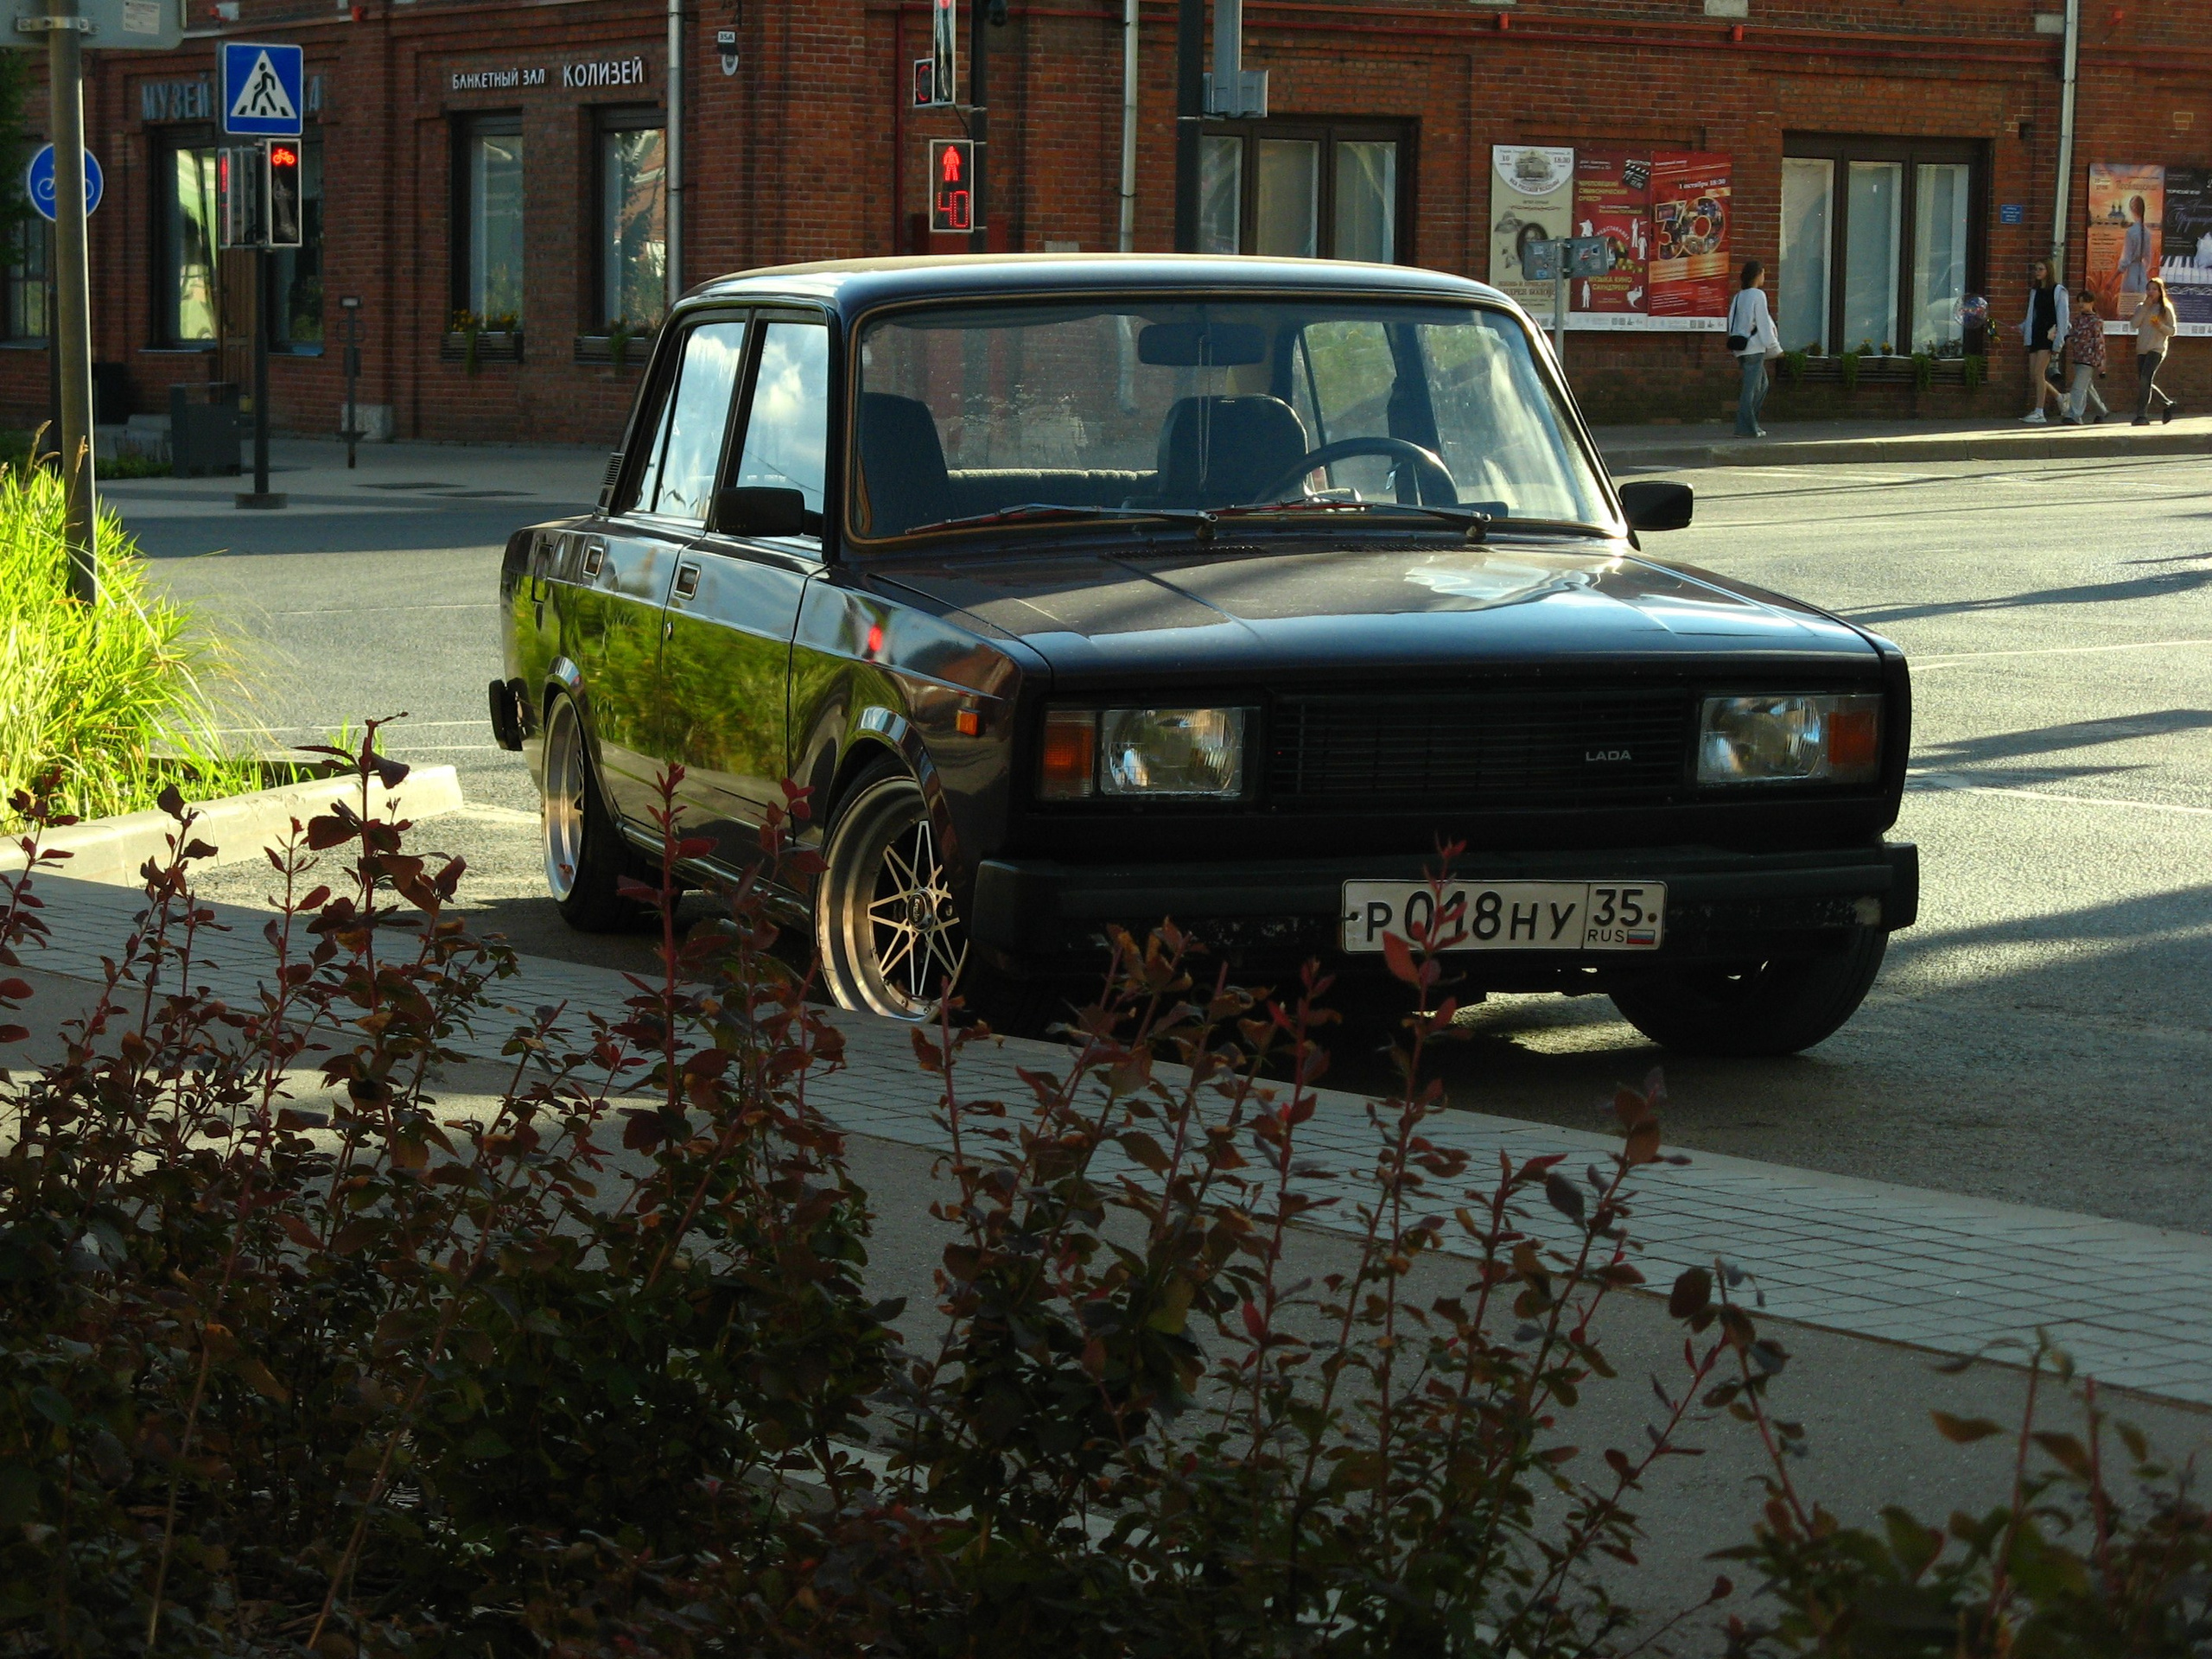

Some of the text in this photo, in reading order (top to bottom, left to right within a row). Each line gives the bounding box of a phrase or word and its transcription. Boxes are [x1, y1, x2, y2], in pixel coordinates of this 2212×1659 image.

[452, 55, 644, 90] БАНКЕТНЫЙ ЗАЛ КОЛИЗЕЙ
[141, 72, 211, 120] МУЗЕЙ
[938, 190, 969, 227] 40
[1586, 750, 1631, 761] LADA
[1593, 888, 1643, 927] 35
[1587, 930, 1625, 944] RUS
